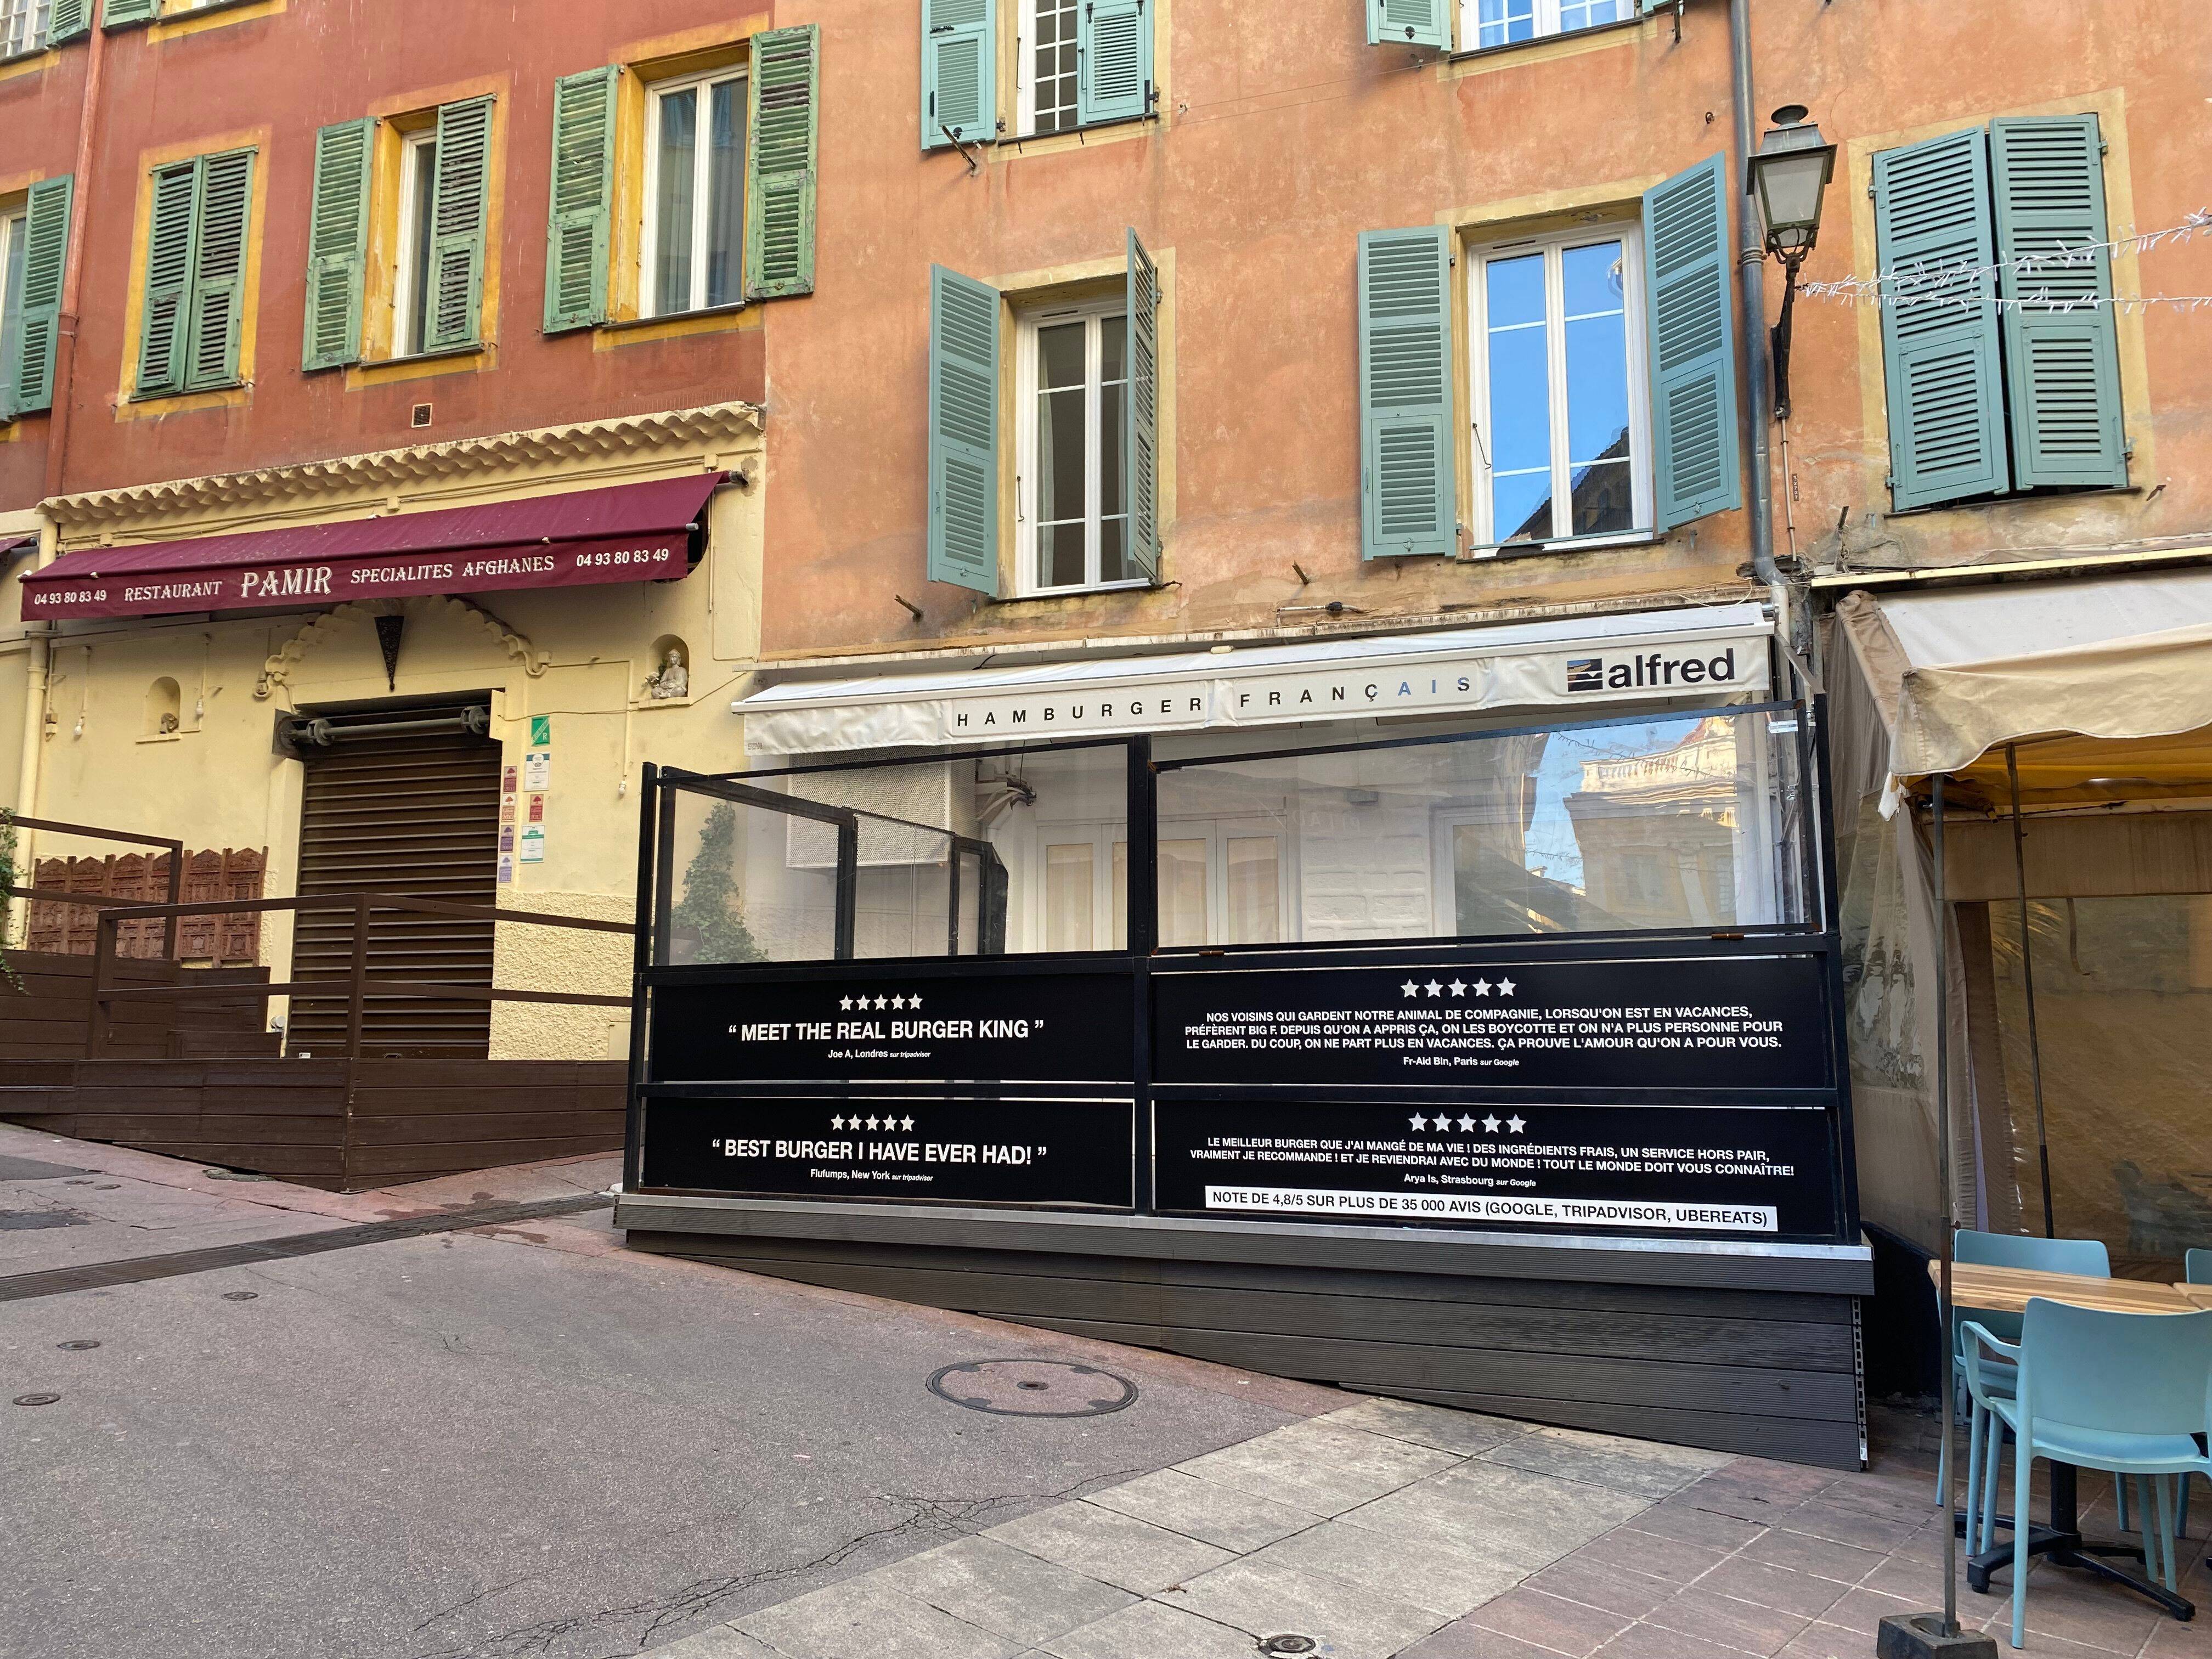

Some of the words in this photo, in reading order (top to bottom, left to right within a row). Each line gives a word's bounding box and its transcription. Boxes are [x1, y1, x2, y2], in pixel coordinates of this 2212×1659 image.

[576, 554, 592, 567] 04
[595, 552, 611, 566] 93
[614, 551, 630, 565] 80
[633, 549, 649, 563] 83
[652, 548, 669, 561] 49
[124, 581, 223, 602] RESTAURANT
[240, 566, 332, 598] PAMIR
[350, 563, 453, 584] SPECIALITES
[461, 556, 555, 577] AFGHANES
[34, 593, 47, 605] 04
[49, 592, 61, 604] 93
[64, 591, 77, 603] 80
[78, 590, 92, 602] 83
[93, 589, 107, 601] 49
[1607, 647, 1735, 689] alfred
[957, 697, 1201, 727] HAMBURGER
[1240, 677, 1470, 708] FRANÇAIS
[543, 732, 548, 741] R
[1206, 1012, 1229, 1022] NOS
[1231, 1012, 1274, 1022] VOISINS
[1276, 1011, 1295, 1022] QUI
[1298, 1011, 1352, 1022] GARDENT
[1355, 1010, 1395, 1020] NOTRE
[1396, 1009, 1443, 1020] ANIMAL
[1445, 1009, 1462, 1020] DE
[1464, 1009, 1542, 1021] COMPAGNIE,
[1545, 1008, 1622, 1019] LORSQU'ON
[1625, 1007, 1650, 1018] EST
[1654, 1007, 1672, 1018] EN
[1674, 1006, 1752, 1019] VACANCES,
[741, 1023, 791, 1041] MEET
[795, 1022, 832, 1040] THE
[837, 1022, 886, 1040] REAL
[891, 1020, 973, 1039] BURGER
[979, 1019, 1029, 1039] KING
[1185, 1023, 1246, 1036] PRÉFÈRENT
[1249, 1025, 1267, 1035] BIG
[1269, 1025, 1278, 1035] F.
[1280, 1024, 1321, 1035] DEPUIS
[1323, 1024, 1360, 1035] QU'ON
[1362, 1024, 1372, 1034] A
[1373, 1024, 1417, 1034] APPRIS
[1419, 1024, 1439, 1036] ÇA,
[1441, 1024, 1460, 1034] ON
[1463, 1023, 1486, 1034] LES
[1488, 1023, 1556, 1034] BOYCOTTE
[1559, 1023, 1576, 1034] ET
[1578, 1023, 1598, 1034] ON
[1601, 1023, 1624, 1033] N'A
[1627, 1022, 1662, 1033] PLUS
[1664, 1022, 1740, 1032] PERSONNE
[1742, 1021, 1783, 1032] POUR
[1187, 1039, 1199, 1049] LE
[1201, 1039, 1249, 1049] GARDER.
[1251, 1039, 1267, 1048] DU
[1269, 1039, 1302, 1050] COUP,
[1304, 1038, 1321, 1048] ON
[1324, 1038, 1340, 1048] NE
[1342, 1038, 1372, 1048] PART
[1374, 1038, 1405, 1048] PLUS
[1407, 1038, 1424, 1048] EN
[1426, 1037, 1494, 1048] VACANCES.
[1497, 1037, 1516, 1050] ÇA
[1518, 1037, 1571, 1048] PROUVE
[1573, 1037, 1634, 1048] L'AMOUR
[1637, 1037, 1680, 1048] QU'ON
[1684, 1037, 1694, 1048] A
[1697, 1037, 1736, 1048] POUR
[1739, 1036, 1782, 1047] VOUS.
[828, 1049, 843, 1058] Joe
[844, 1049, 853, 1059] A,
[855, 1049, 888, 1058] Londres
[900, 1051, 932, 1059] tripadvisor
[1403, 1057, 1431, 1065] Fr-Aid
[1454, 1057, 1478, 1065] Paris
[1493, 1058, 1520, 1067] Google
[725, 1139, 771, 1157] BEST
[775, 1140, 853, 1159] BURGER
[859, 1142, 864, 1160] I
[869, 1142, 919, 1161] HAVE
[925, 1143, 976, 1163] EVER
[983, 1144, 1031, 1165] HAD!
[1207, 1137, 1220, 1147] LE
[1222, 1137, 1272, 1148] MEILLEUR
[1274, 1138, 1318, 1149] BURGER
[1320, 1139, 1343, 1150] QUE
[1344, 1140, 1364, 1150] J'AI
[1367, 1139, 1407, 1152] MANGÉ
[1408, 1142, 1424, 1152] DE
[1426, 1142, 1444, 1153] MA
[1446, 1143, 1464, 1153] VIE
[1472, 1143, 1496, 1154] DES
[1498, 1142, 1577, 1156] INGRÉDIENTS
[1579, 1146, 1618, 1159] FRAIS,
[1621, 1147, 1639, 1158] UN
[1641, 1148, 1695, 1159] SERVICE
[1697, 1149, 1734, 1160] HORS
[1737, 1150, 1770, 1163] PAIR,
[1190, 1149, 1241, 1160] VRAIMENT
[1242, 1150, 1255, 1160] JE
[1257, 1151, 1333, 1163] RECOMMANDE
[1340, 1153, 1354, 1163] ET
[1356, 1154, 1369, 1164] JE
[1372, 1154, 1437, 1165] REVIENDRAI
[1439, 1156, 1469, 1166] AVEC
[1471, 1157, 1488, 1167] DU
[1491, 1158, 1534, 1169] MONDE
[1543, 1159, 1576, 1170] TOUT
[1578, 1160, 1593, 1170] LE
[1596, 1160, 1642, 1172] MONDE
[1644, 1162, 1674, 1172] DOIT
[1677, 1163, 1712, 1174] VOUS
[1715, 1162, 1795, 1176] CONNAÎTRE!
[810, 1169, 850, 1180] Flufumps,
[851, 1170, 870, 1180] New
[871, 1170, 890, 1180] York
[902, 1173, 934, 1182] tripadvisor
[1403, 1173, 1425, 1184] Arya
[1441, 1175, 1494, 1187] Strasbourg
[1510, 1178, 1537, 1188] Google
[1213, 1191, 1248, 1203] NOTE
[1251, 1193, 1269, 1204] DE
[1273, 1194, 1304, 1207] 4,8/5
[1307, 1195, 1335, 1207] SUR
[1339, 1196, 1375, 1209] PLUS
[1379, 1197, 1398, 1209] DE
[1402, 1198, 1418, 1210] 35
[1421, 1199, 1445, 1211] 000
[1449, 1200, 1481, 1213] AVIS
[1486, 1201, 1558, 1218] (GOOGLE,
[1561, 1205, 1671, 1223] TRIPADVISOR,
[1676, 1209, 1767, 1227] UBEREATS)
